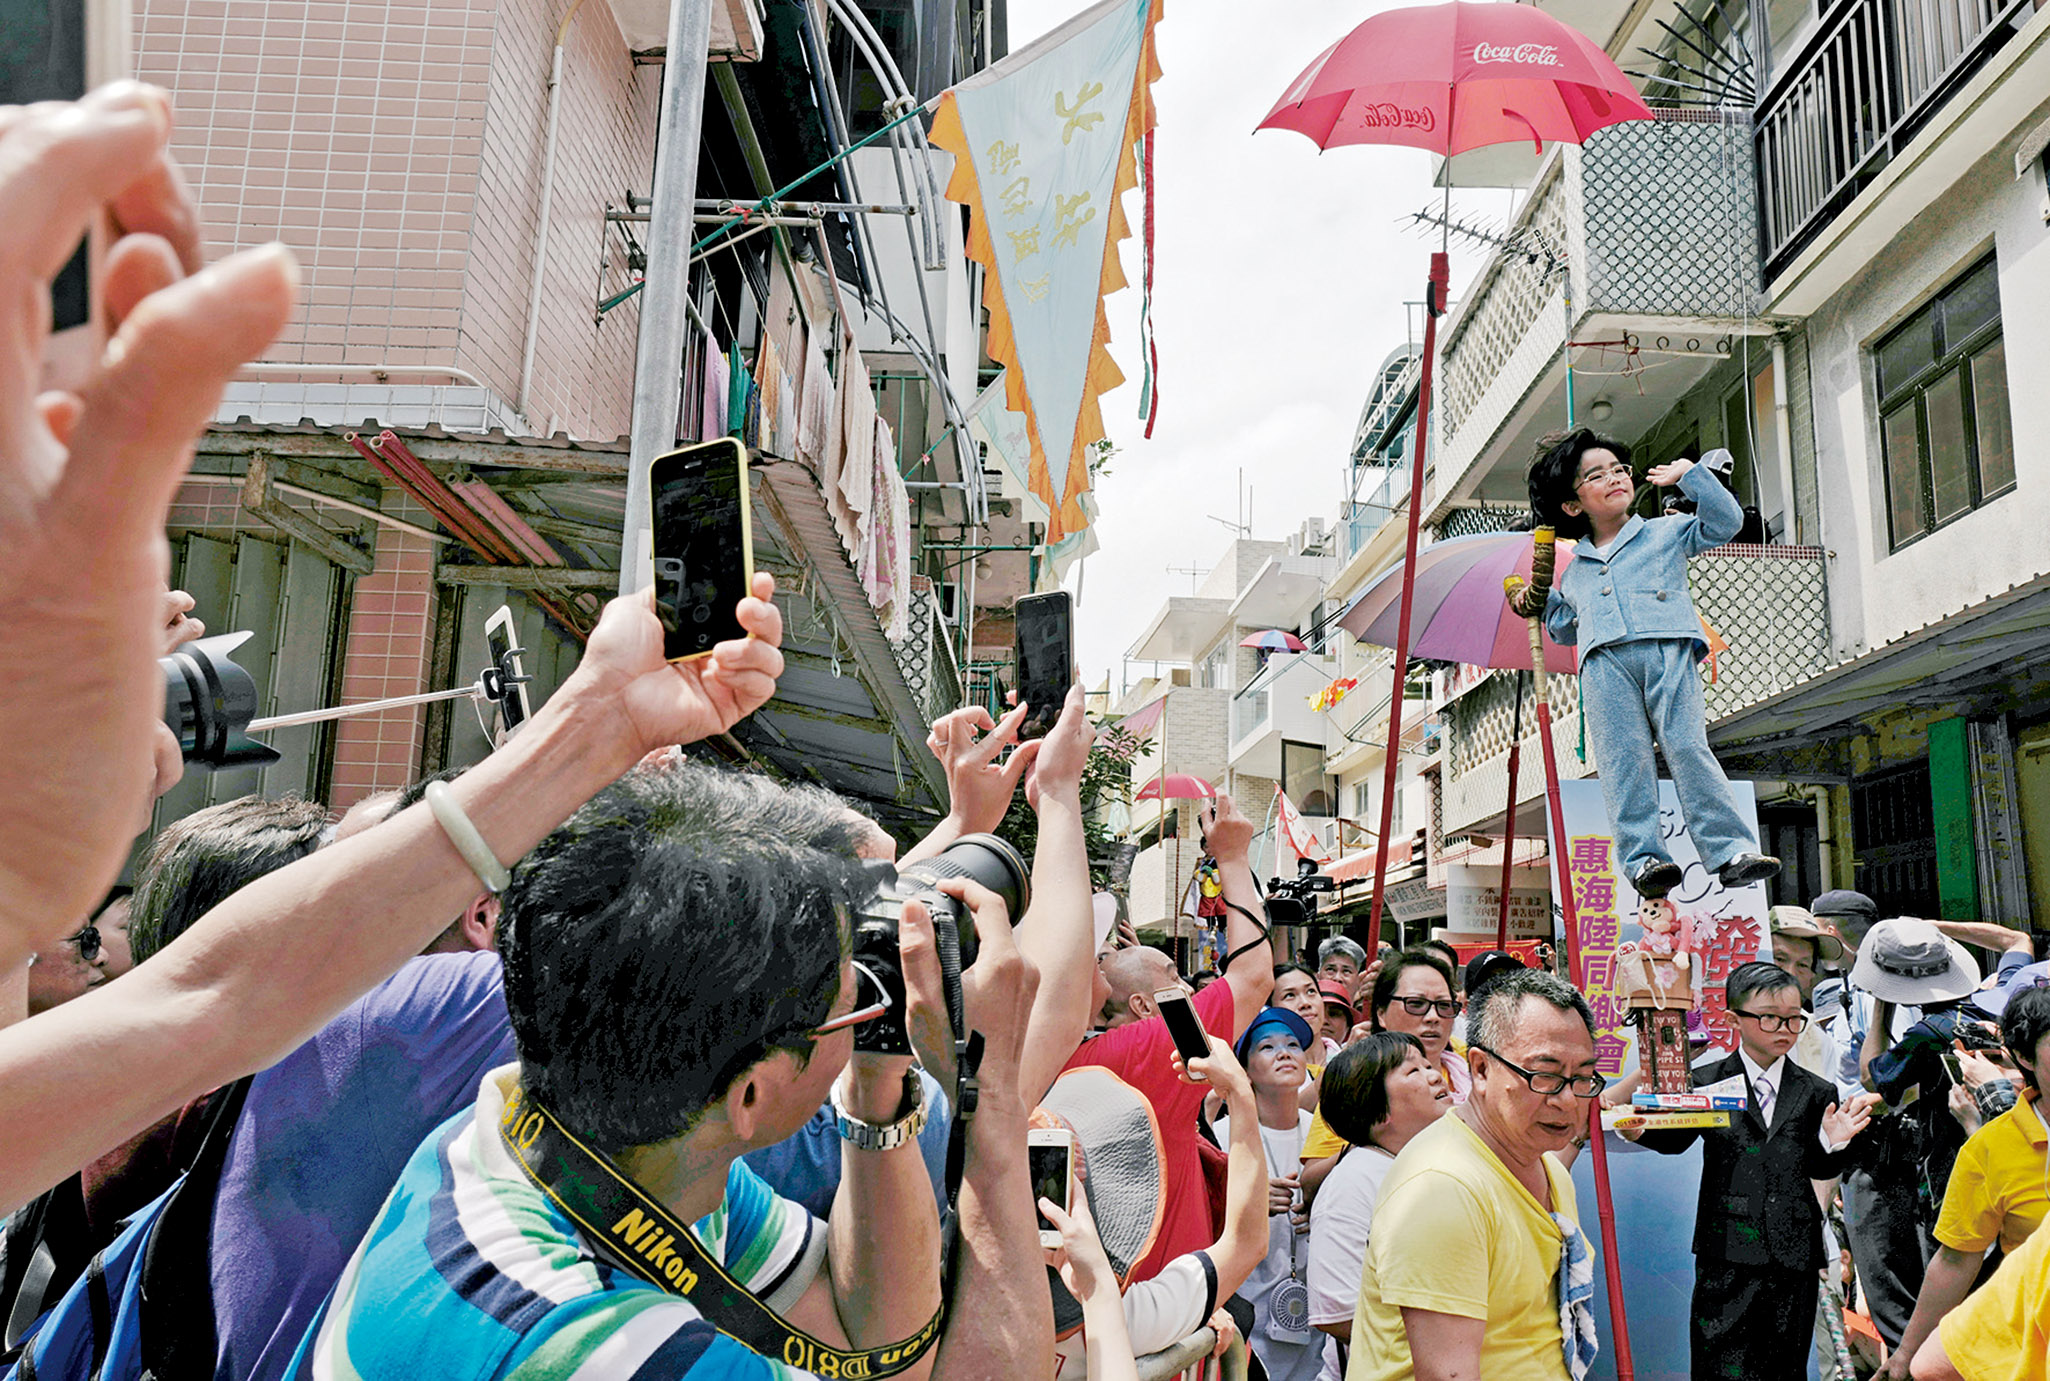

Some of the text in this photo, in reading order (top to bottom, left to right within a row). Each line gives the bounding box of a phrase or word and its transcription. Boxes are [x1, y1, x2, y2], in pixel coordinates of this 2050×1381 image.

[1473, 41, 1560, 67] Coca-Cola
[1569, 836, 1630, 1076] 惠海陸同鄉會
[611, 1207, 699, 1296] Nikon
[879, 1303, 945, 1365] ikon
